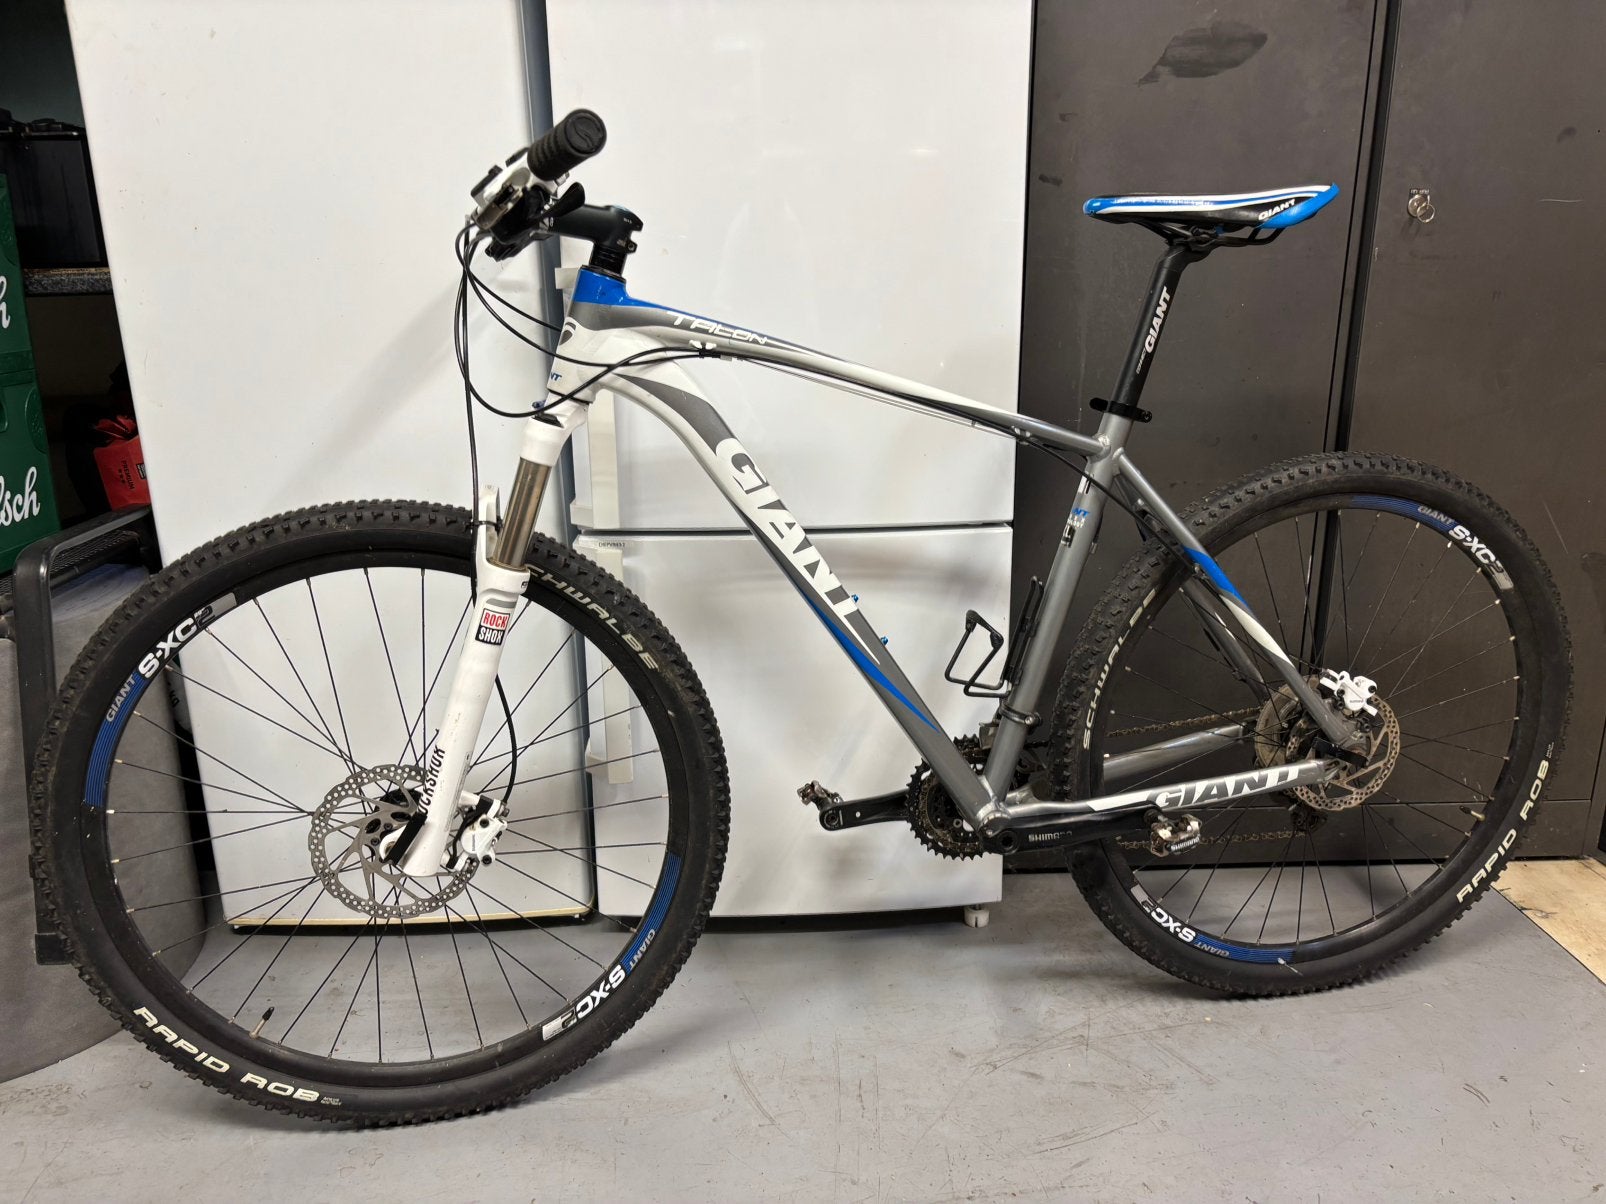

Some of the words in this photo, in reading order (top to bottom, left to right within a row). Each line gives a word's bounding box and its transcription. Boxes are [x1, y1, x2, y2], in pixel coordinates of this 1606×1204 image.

[1258, 198, 1296, 221] GIANT
[667, 310, 768, 344] TALON
[1144, 286, 1171, 354] GIANT
[716, 437, 858, 618] GIANT
[1417, 505, 1456, 525] GIANT
[478, 626, 504, 644] SHOX
[482, 611, 509, 629] ROCK
[525, 563, 661, 671] CHWALBE
[106, 674, 137, 722] GIANT
[417, 745, 446, 817] OCKSHOX
[1145, 767, 1300, 810] GIANT
[1456, 828, 1517, 904] RAPID
[1519, 759, 1550, 822] ROB
[629, 928, 656, 970] GIANT
[1194, 941, 1230, 957] GIANT
[133, 1006, 230, 1073] RAPID
[240, 1072, 320, 1103] ROB
